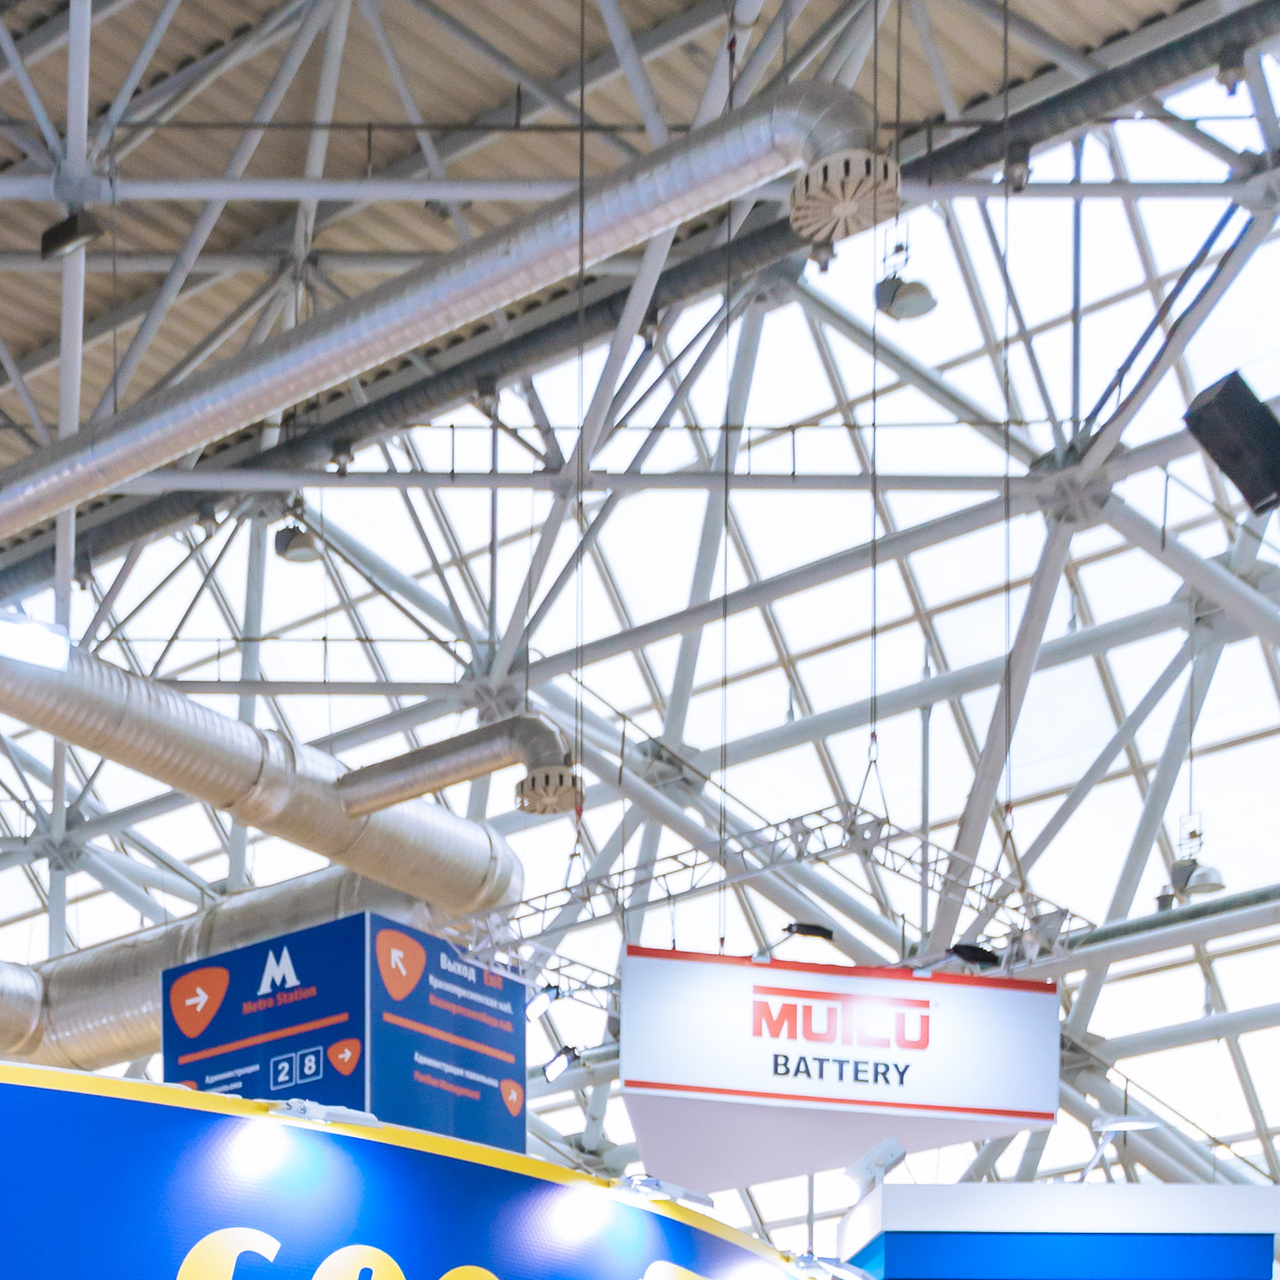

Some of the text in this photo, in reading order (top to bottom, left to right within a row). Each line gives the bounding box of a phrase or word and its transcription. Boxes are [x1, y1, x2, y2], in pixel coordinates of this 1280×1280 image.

[440, 952, 477, 984] Выход
[242, 985, 317, 1015] Metro Station
[278, 1054, 316, 1083] 2 8
[773, 1053, 911, 1087] BATTERY
